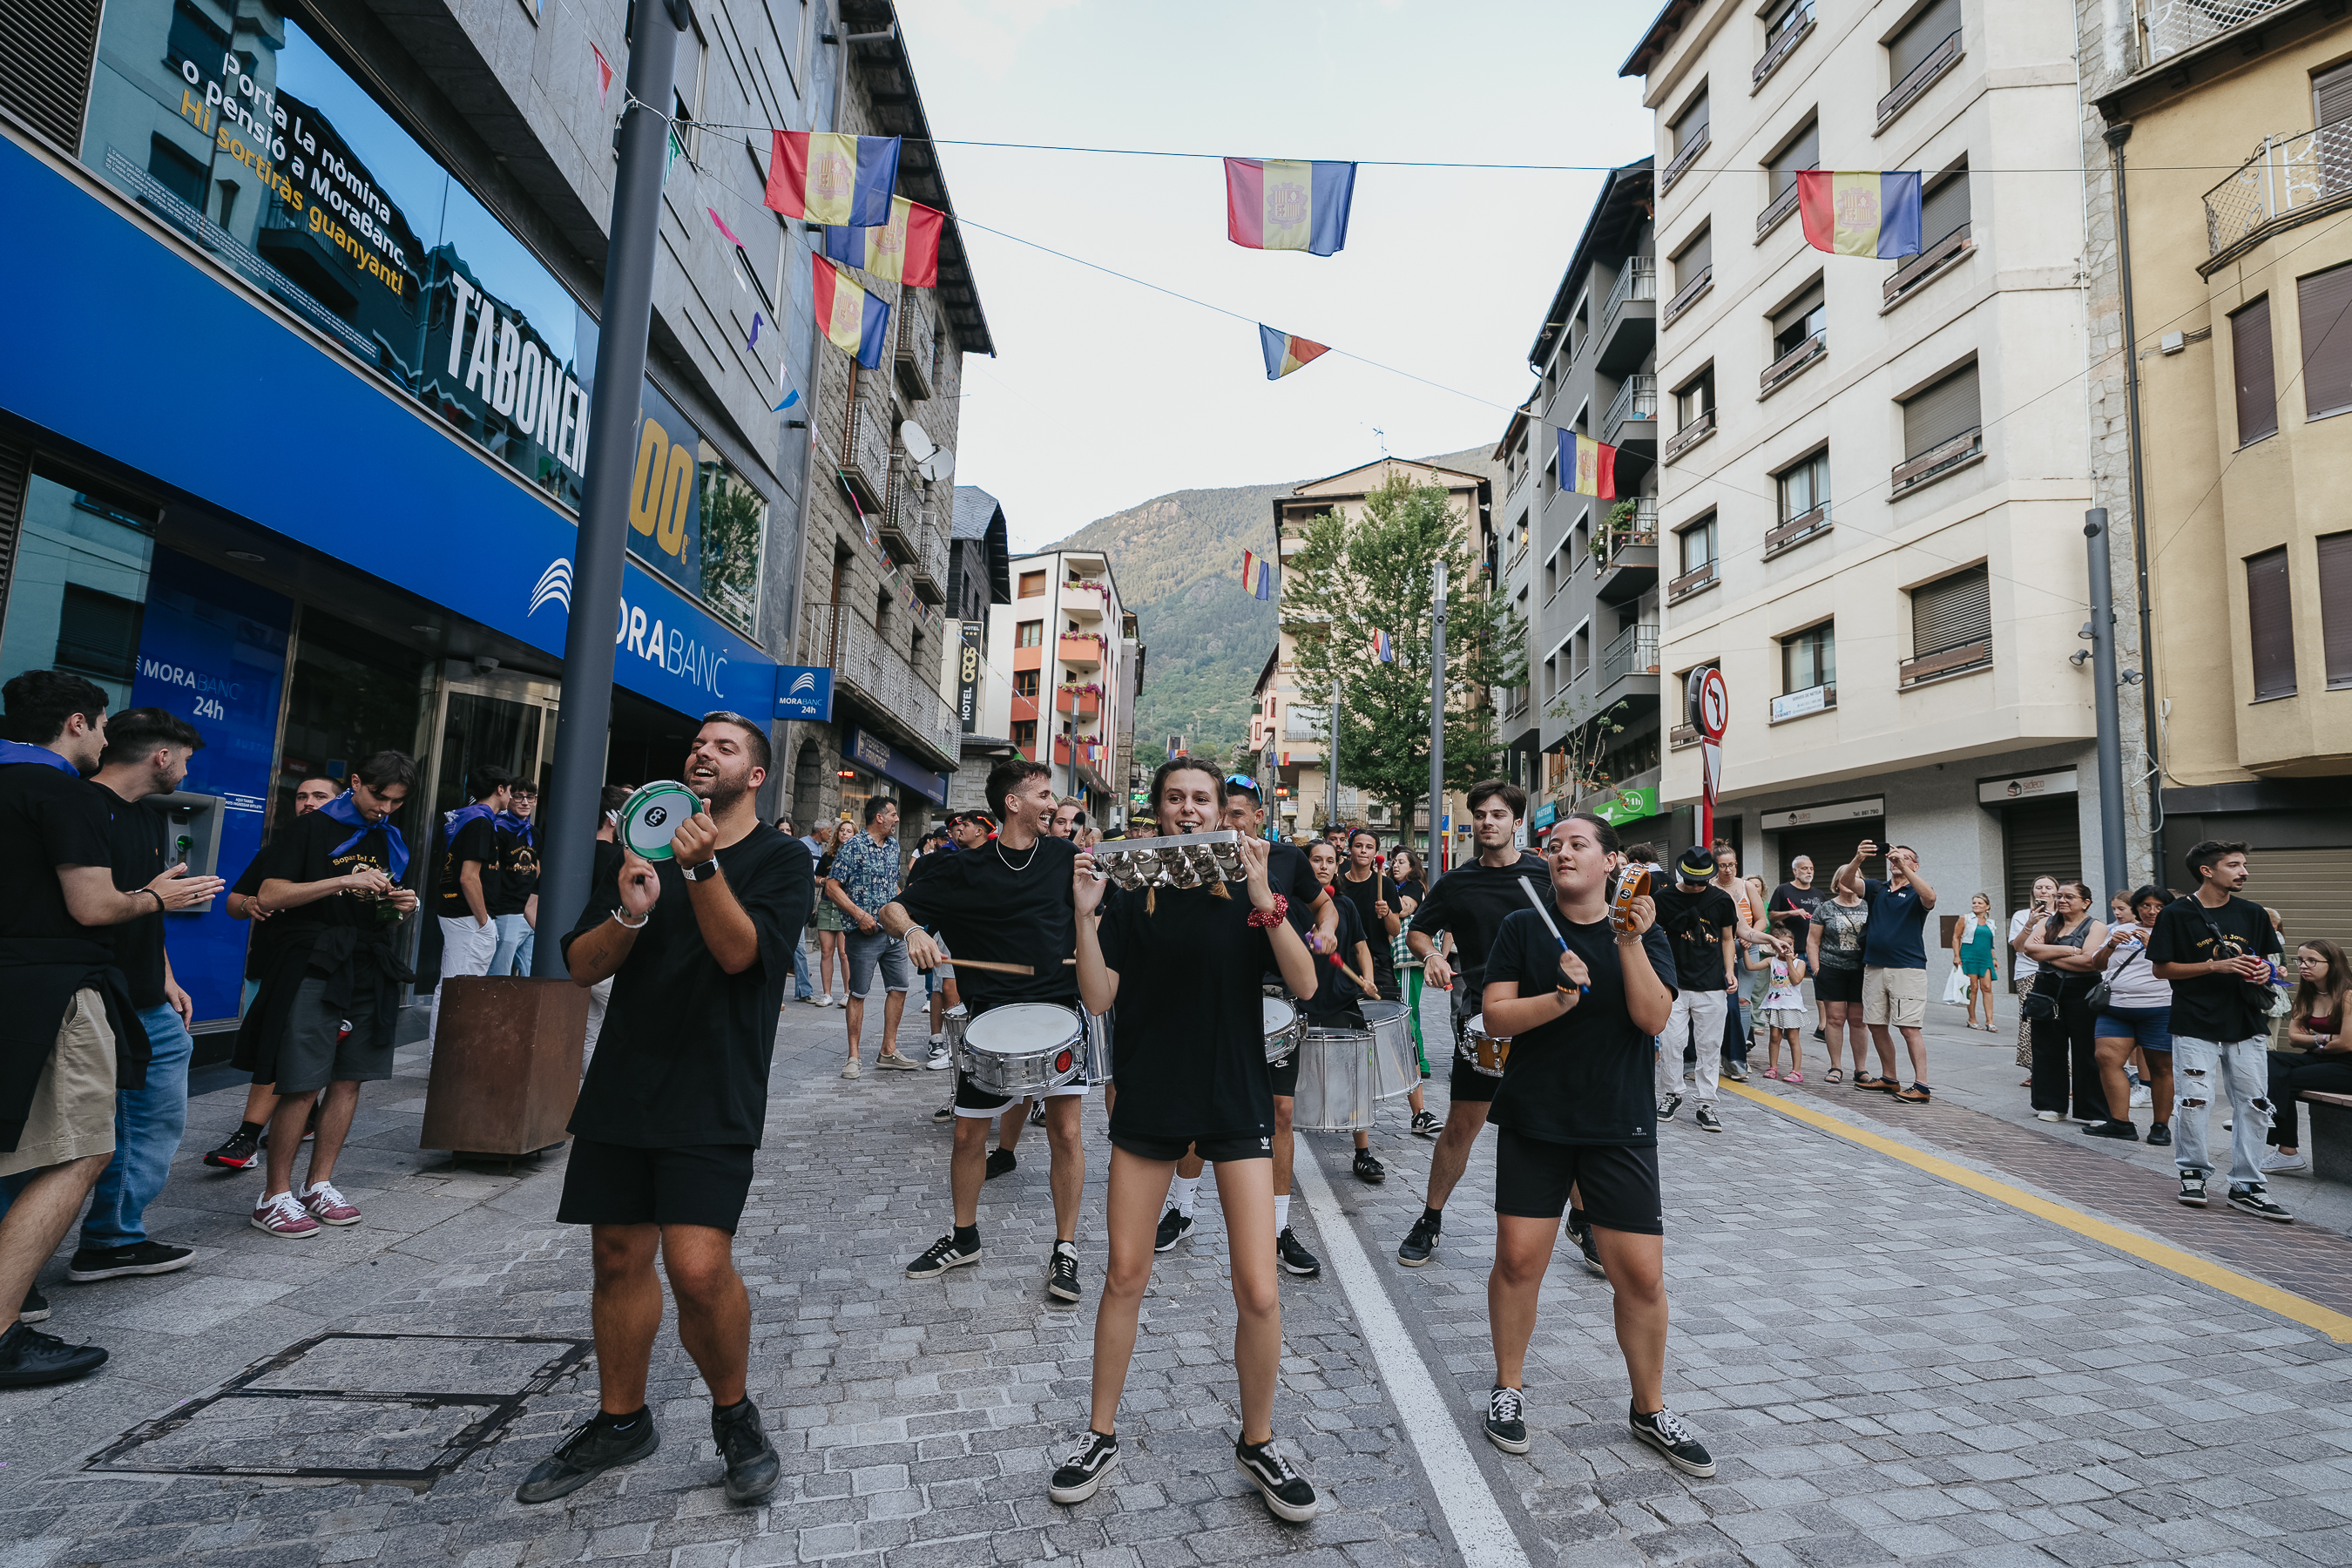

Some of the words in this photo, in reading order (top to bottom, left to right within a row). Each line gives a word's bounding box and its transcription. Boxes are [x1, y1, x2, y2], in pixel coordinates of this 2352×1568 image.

[222, 52, 287, 130] Porta
[294, 116, 316, 156] la
[321, 148, 391, 225] nòmina
[182, 60, 199, 84] o
[205, 80, 286, 161] pensió
[291, 155, 304, 180] a
[310, 168, 408, 271] MoraBanc.
[180, 89, 210, 134] Hi
[216, 126, 304, 211] sortiràs
[308, 206, 403, 296] guanyant!
[143, 659, 240, 700] MORABANC
[961, 646, 977, 683] OROS
[193, 696, 224, 720] 24h
[779, 697, 822, 706] MORABANC
[962, 686, 972, 721] HOTEL
[865, 749, 887, 771] PRINCIPAT
[867, 734, 890, 759] FERRETERIA
[1537, 805, 1552, 818] PASTEUR
[2197, 937, 2214, 947] Sopa
